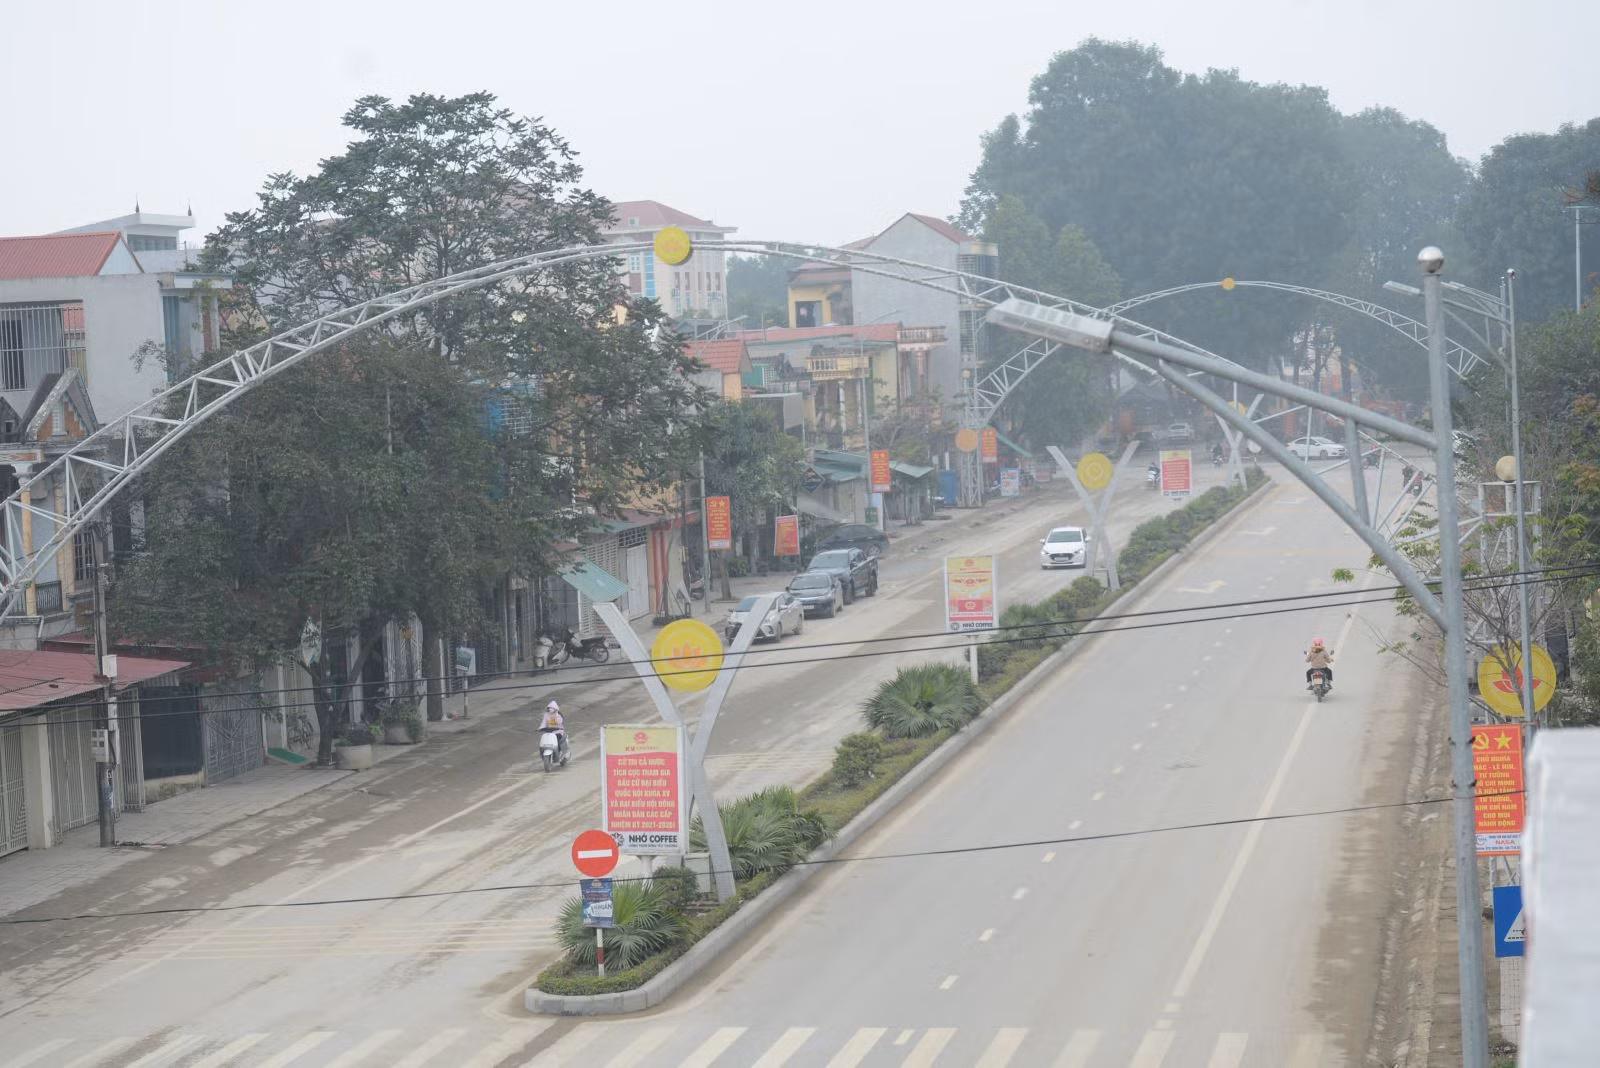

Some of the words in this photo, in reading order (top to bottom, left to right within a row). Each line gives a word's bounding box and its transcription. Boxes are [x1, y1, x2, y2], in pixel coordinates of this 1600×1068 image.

[614, 768, 627, 776] TÍCH
[628, 769, 640, 778] CỰC
[614, 788, 631, 797] QUỐC
[633, 790, 643, 798] HỘI
[614, 810, 631, 818] NHÂN
[632, 810, 644, 818] DÂN
[646, 810, 659, 818] CÁC
[660, 809, 672, 818] CẤP
[629, 832, 647, 843] NHỚ
[649, 835, 677, 843] COFFEE
